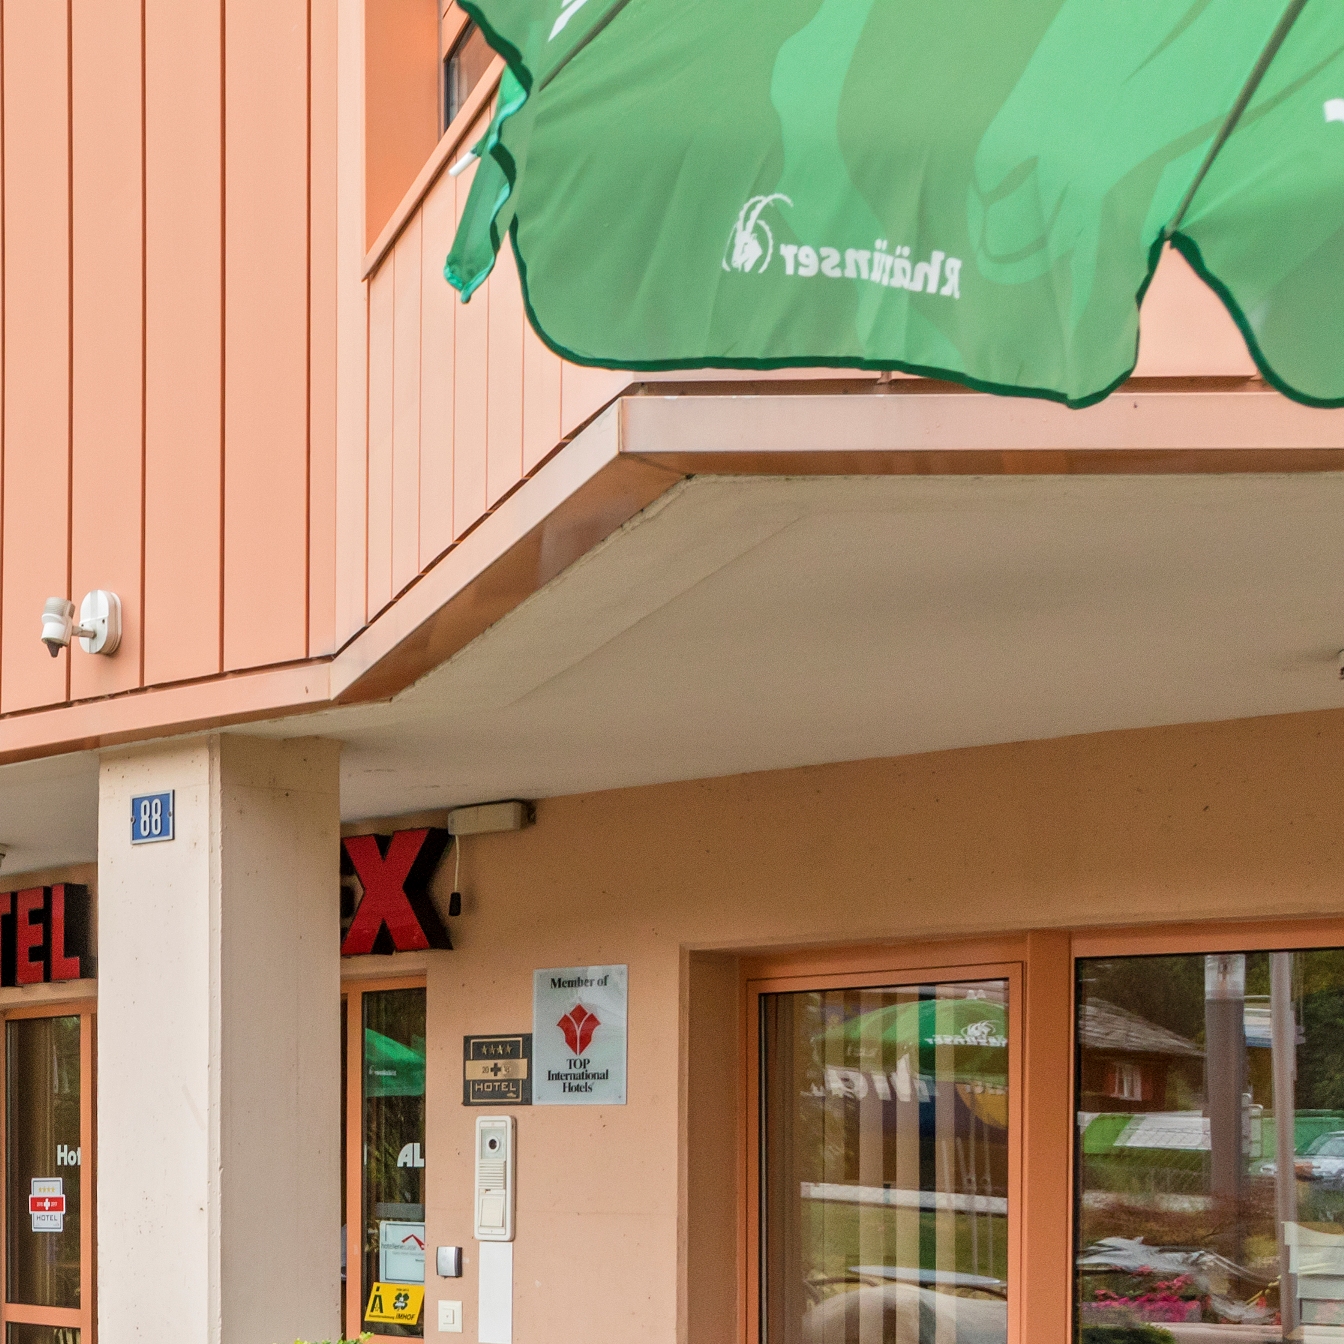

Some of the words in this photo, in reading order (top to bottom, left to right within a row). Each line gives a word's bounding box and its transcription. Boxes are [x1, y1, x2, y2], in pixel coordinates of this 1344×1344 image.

[140, 798, 162, 837] 88
[341, 828, 453, 956] X
[550, 976, 594, 989] Member
[597, 975, 609, 987] of
[566, 1058, 590, 1070] TOP
[547, 1069, 609, 1081] International
[475, 1082, 517, 1092] HOTEL
[562, 1081, 593, 1093] Hotels
[397, 1142, 424, 1168] AL
[36, 1214, 58, 1222] HOTEL
